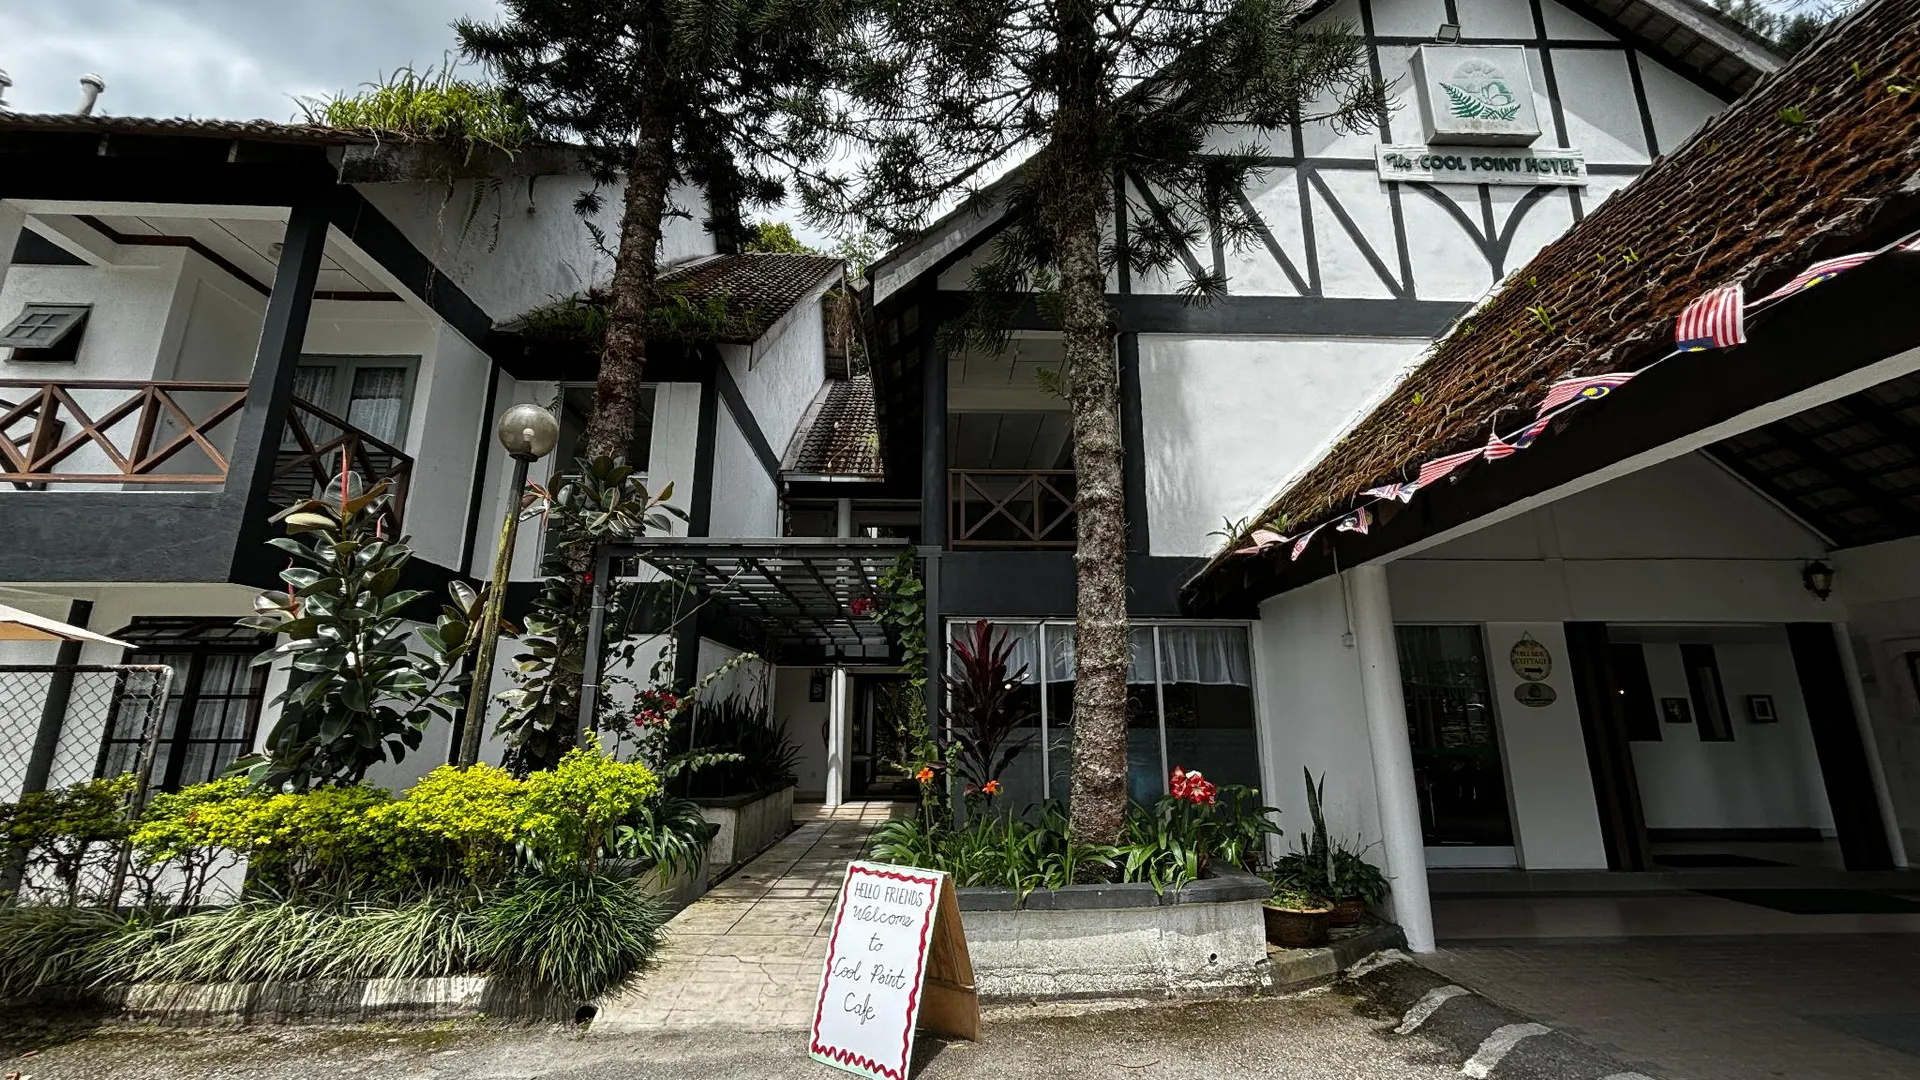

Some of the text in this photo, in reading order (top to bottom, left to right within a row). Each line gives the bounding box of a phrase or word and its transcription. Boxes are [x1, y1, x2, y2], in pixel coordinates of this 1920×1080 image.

[1383, 153, 1579, 174] The COOL POINT HOTEL
[1515, 657, 1547, 665] COTTAGE
[855, 882, 924, 907] HELLO FRIENDS
[853, 905, 914, 927] Welcome
[868, 932, 884, 952] to
[832, 956, 906, 990] Cool Point
[843, 992, 875, 1025] Cafe
